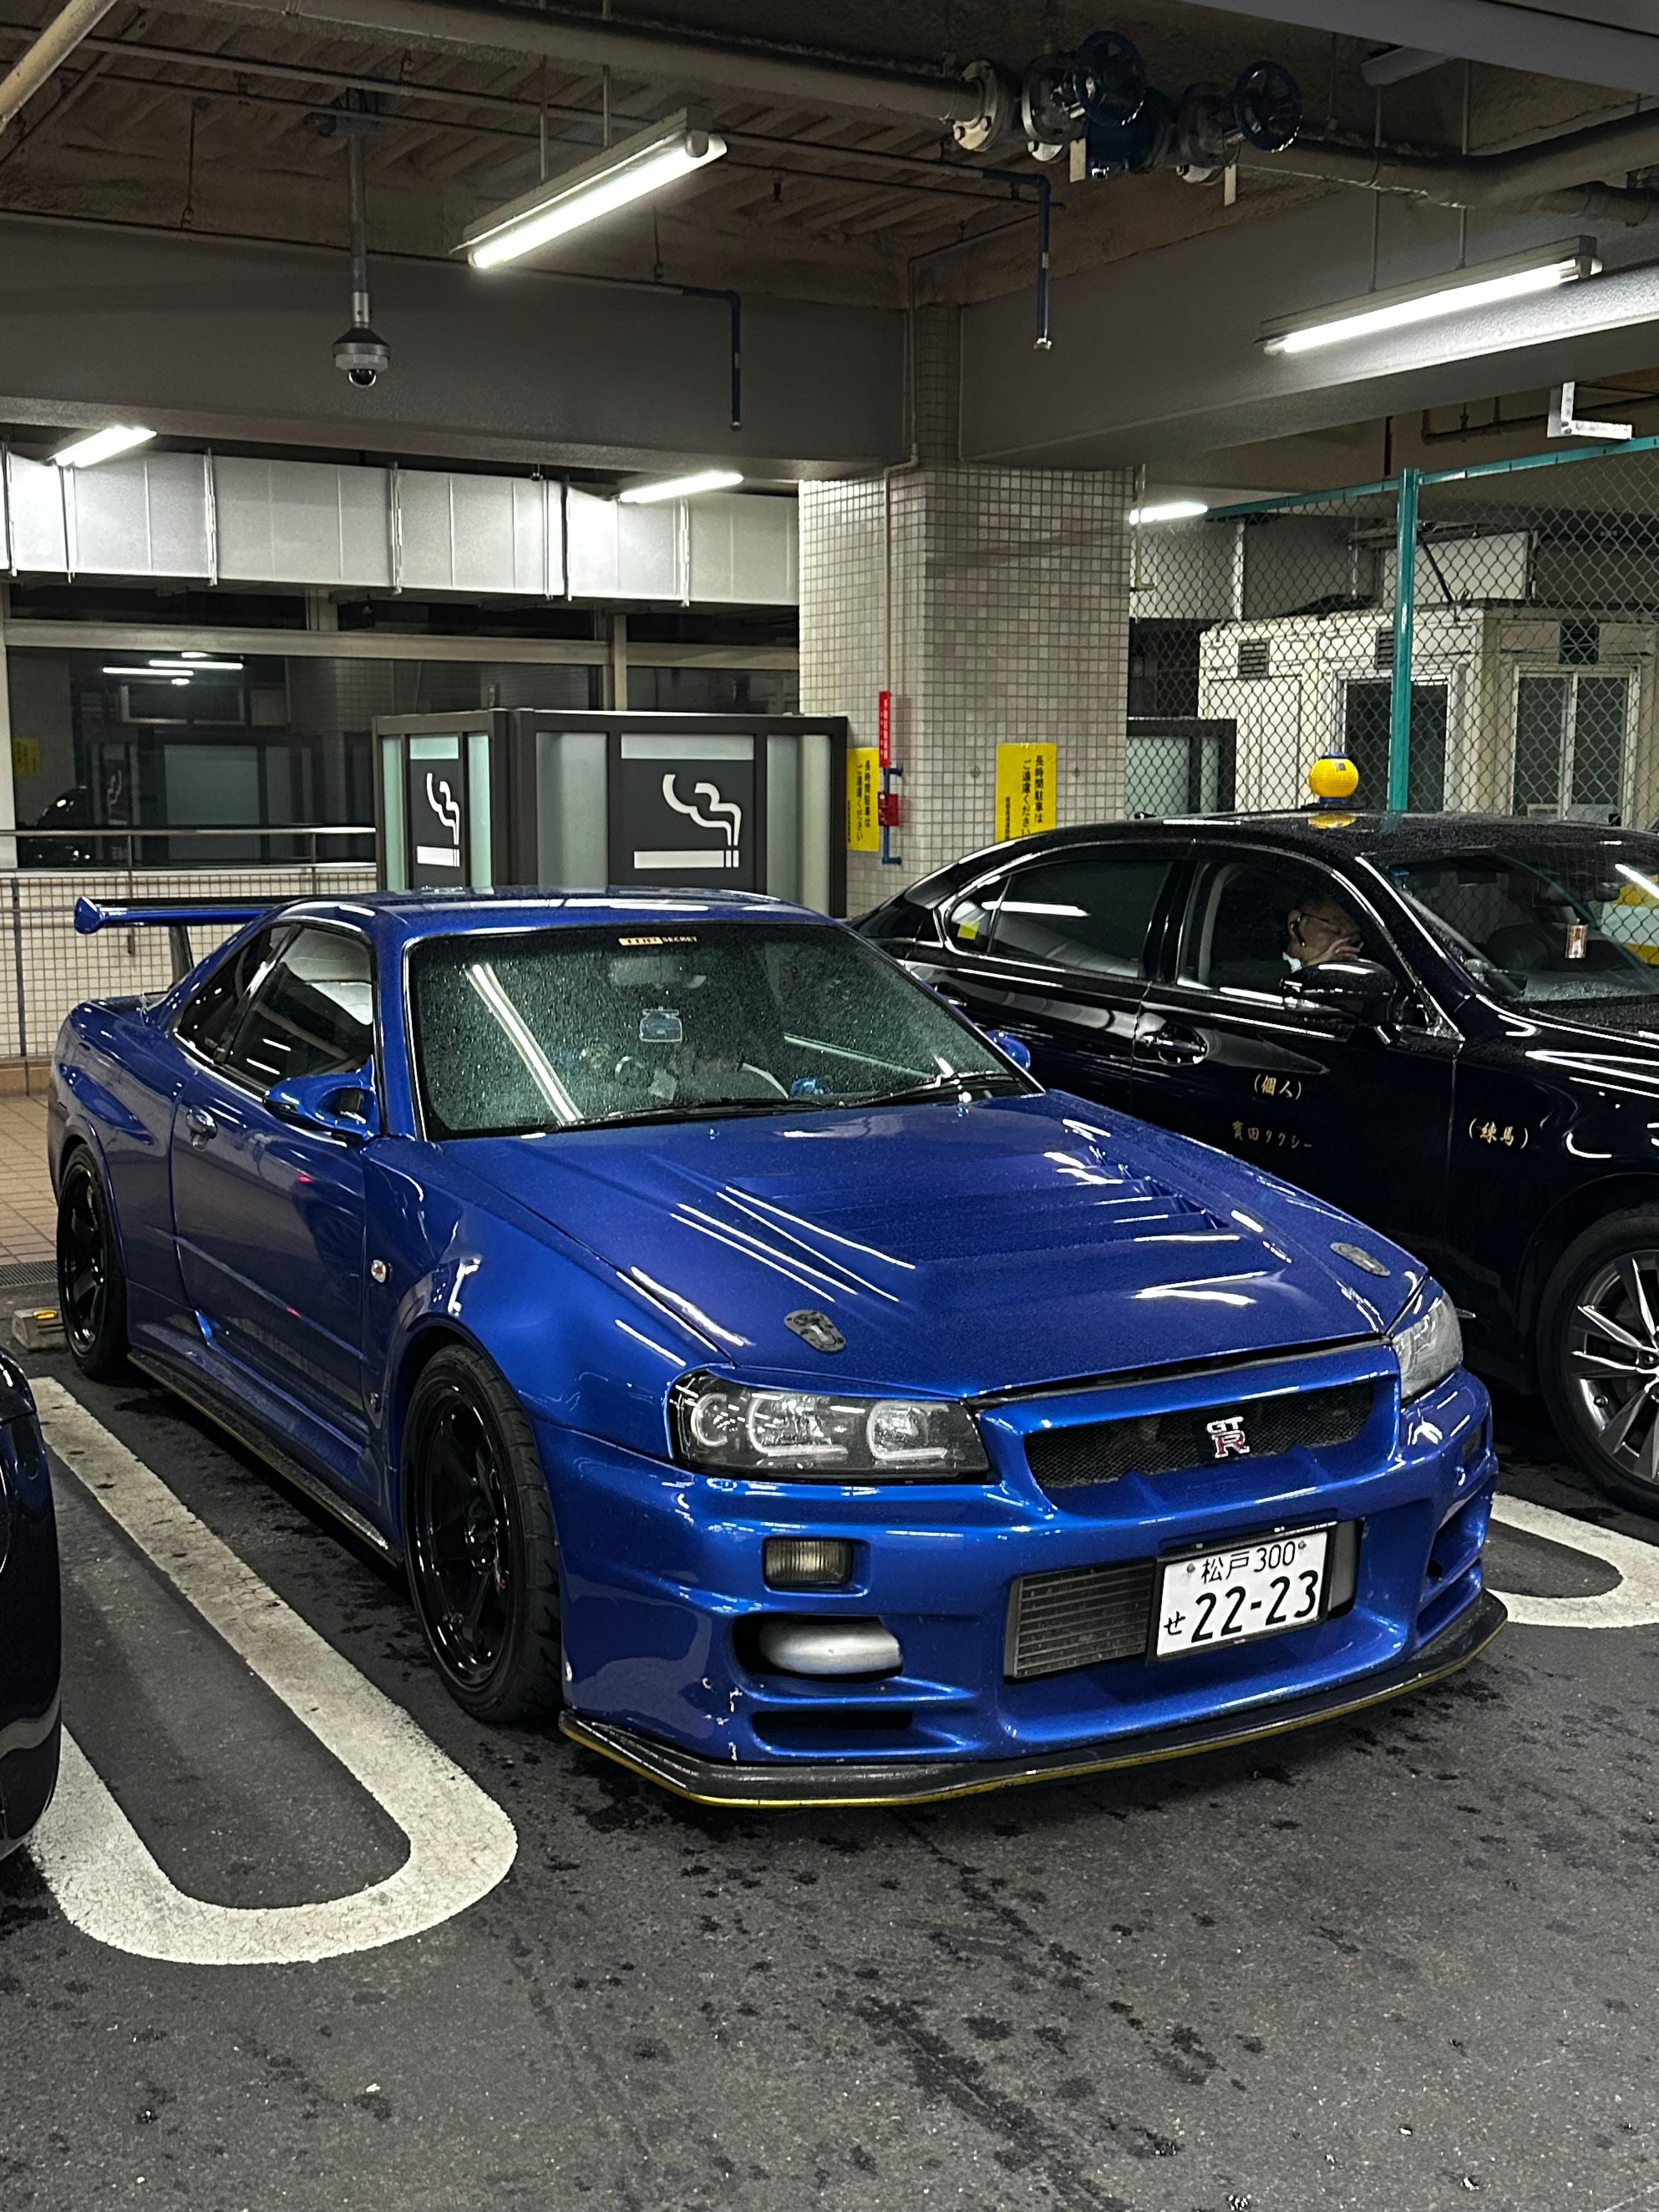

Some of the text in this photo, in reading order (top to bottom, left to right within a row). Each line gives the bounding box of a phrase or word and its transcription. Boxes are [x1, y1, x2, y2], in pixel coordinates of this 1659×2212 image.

[1035, 755, 1044, 823] 長時間駐車は
[1164, 1569, 1319, 1643] せ 22-23
